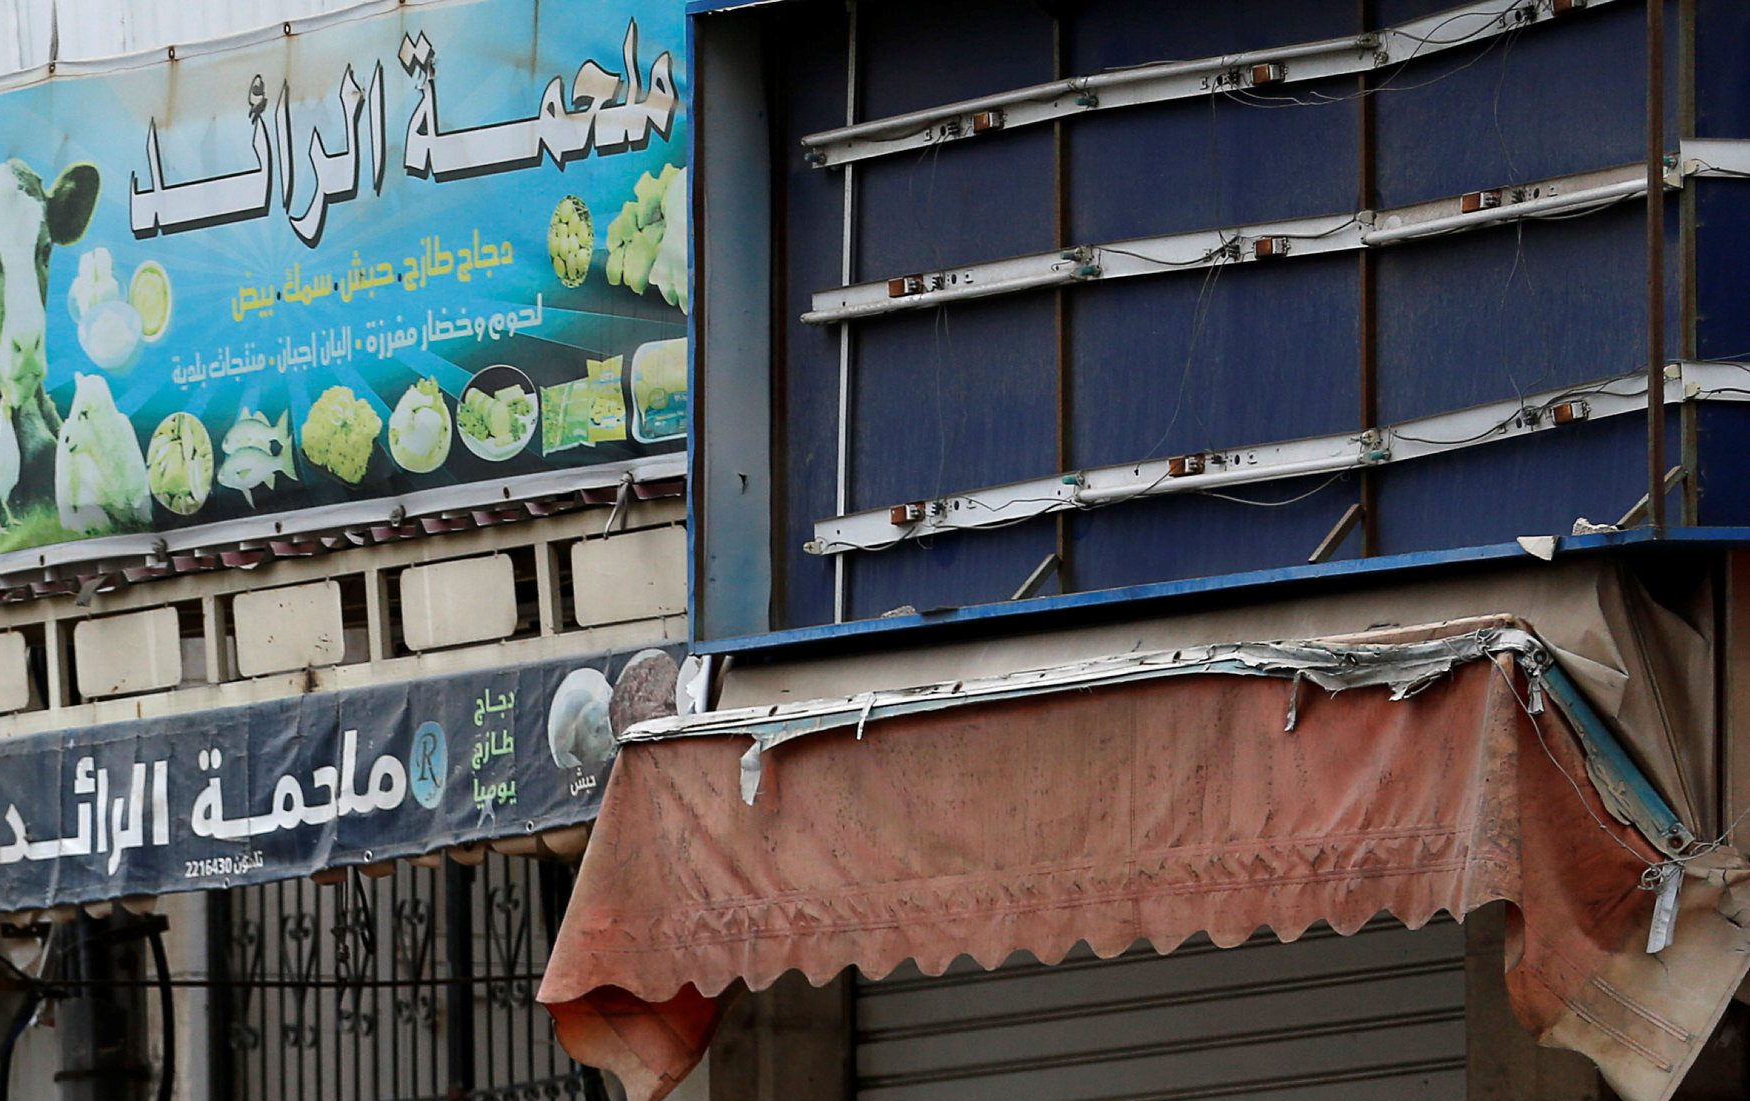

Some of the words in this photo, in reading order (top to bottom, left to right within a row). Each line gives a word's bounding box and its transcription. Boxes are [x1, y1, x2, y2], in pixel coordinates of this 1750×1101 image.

[397, 17, 679, 183] ملحمة
[130, 59, 386, 248] الرائد
[338, 250, 395, 303] حبش
[403, 236, 454, 291] طازج
[457, 229, 514, 282] دجاج
[231, 272, 276, 322] بيض
[283, 261, 333, 305] سمك
[365, 314, 418, 360] مفرزة
[488, 292, 543, 340] لحوم
[172, 352, 207, 390] بلدية
[209, 342, 266, 382] منتجات
[474, 688, 515, 725] دجاج
[472, 730, 515, 770] طازج
[191, 729, 408, 839] ملحمة
[570, 767, 598, 796] حبش
[184, 857, 233, 879] 2216430
